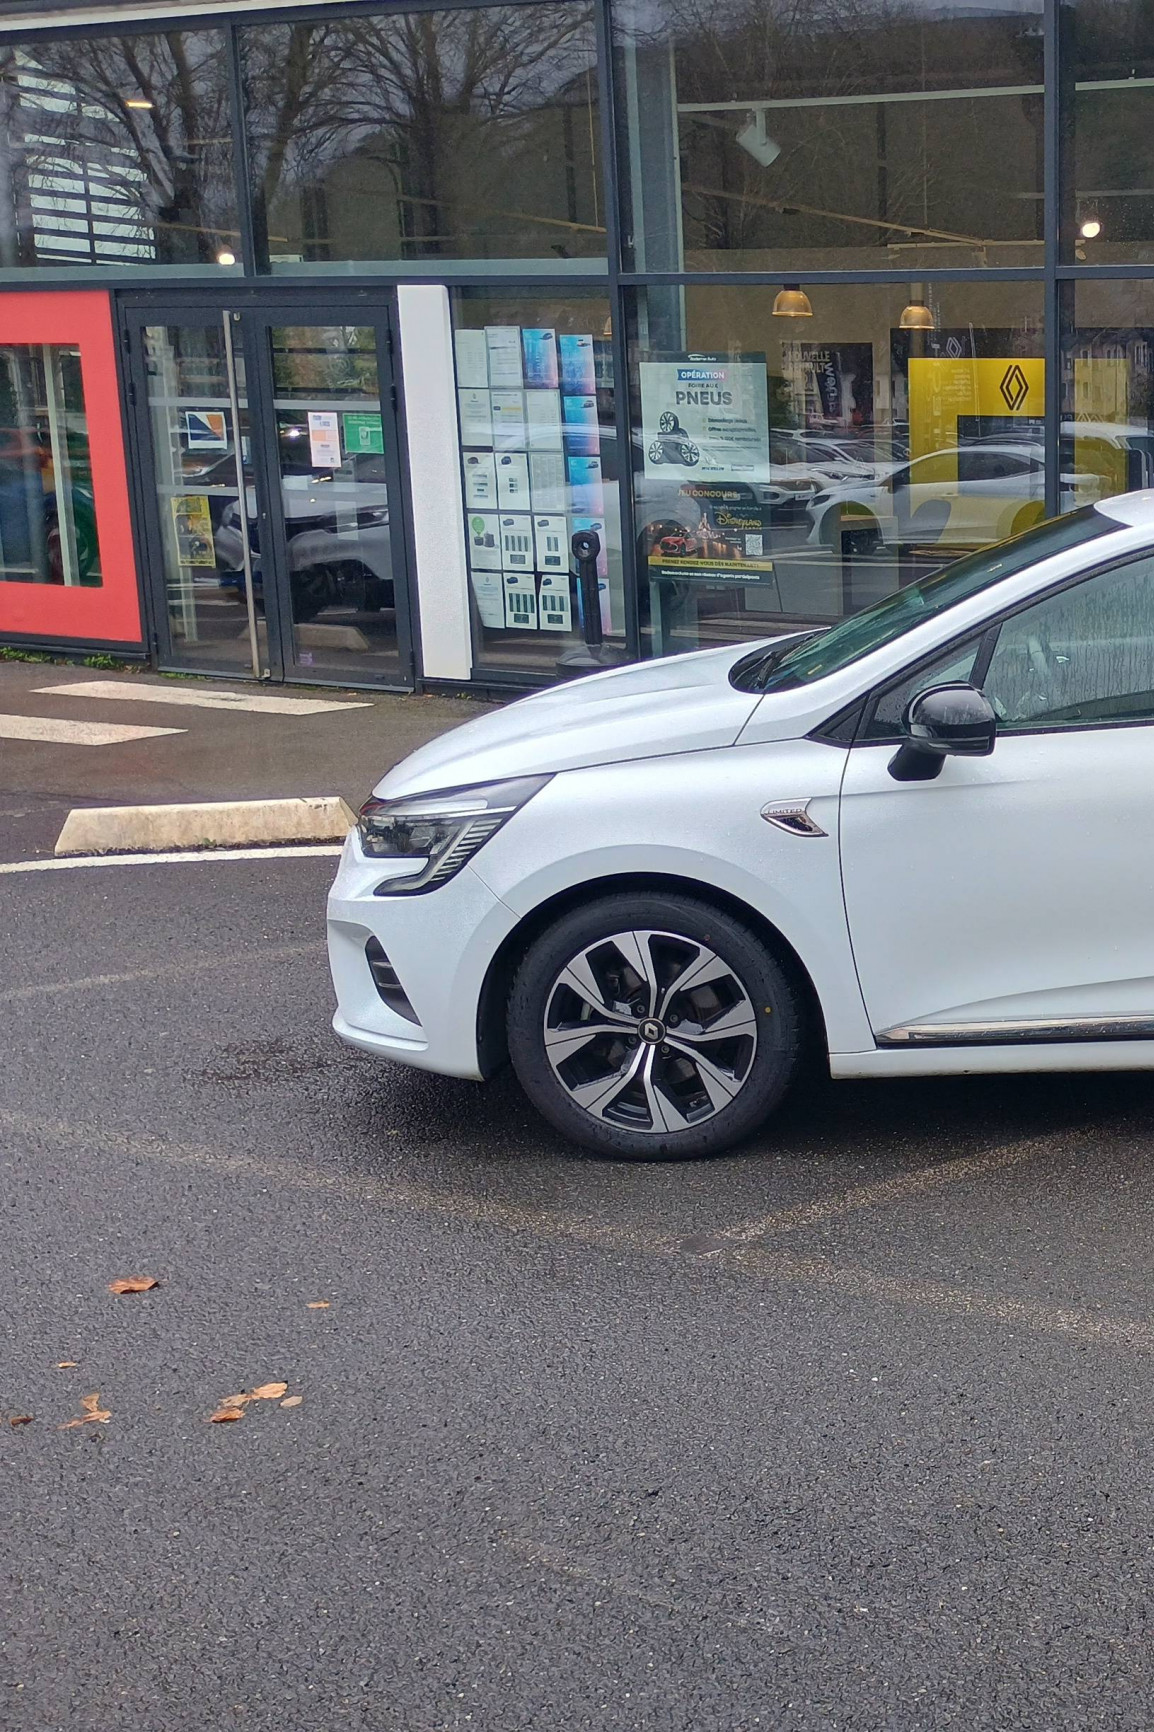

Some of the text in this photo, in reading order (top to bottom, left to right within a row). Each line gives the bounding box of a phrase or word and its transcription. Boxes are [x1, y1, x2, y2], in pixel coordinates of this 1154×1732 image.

[680, 369, 725, 379] OPÉRATION
[675, 391, 733, 406] PNEUS
[692, 489, 738, 498] CONCOURS
